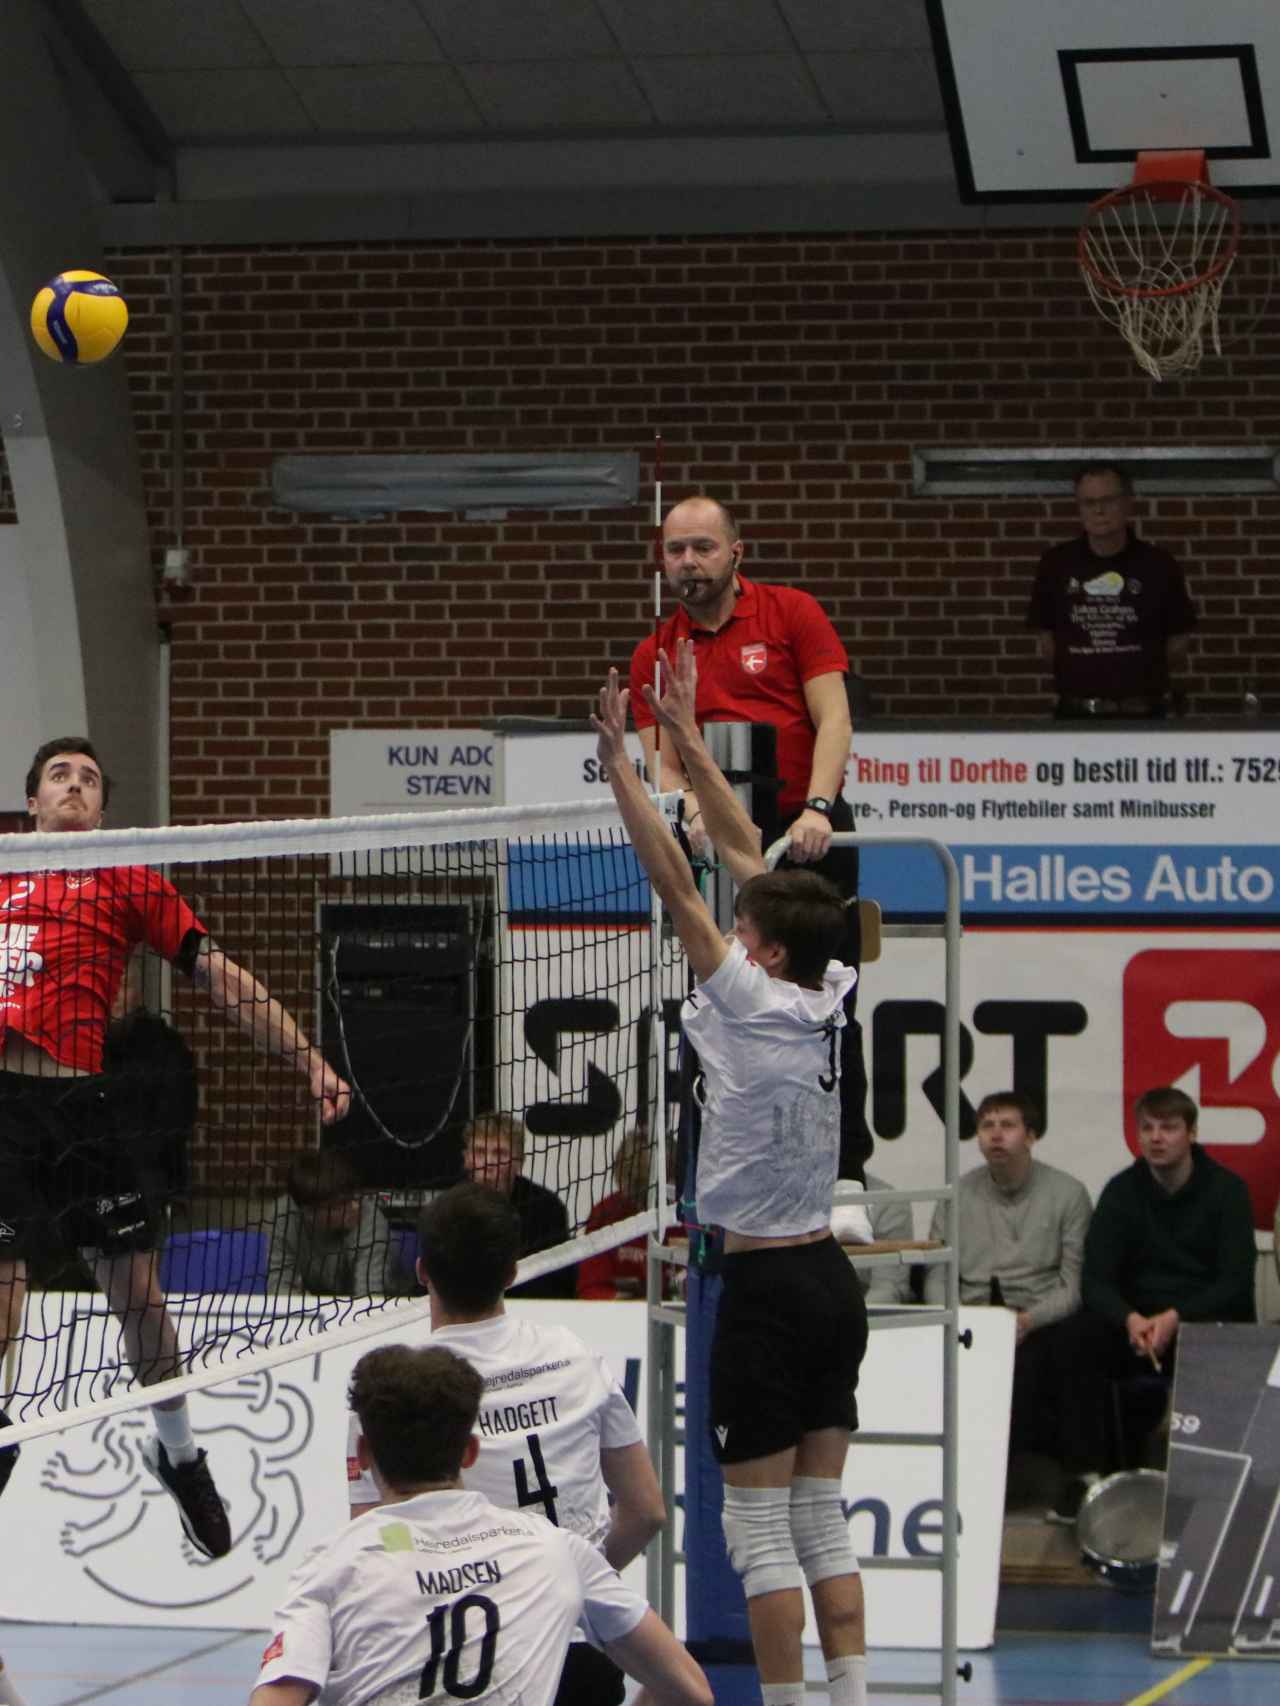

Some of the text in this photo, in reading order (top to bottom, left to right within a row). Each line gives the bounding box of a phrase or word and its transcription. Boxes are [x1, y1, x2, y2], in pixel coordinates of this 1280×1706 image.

[388, 746, 438, 766] KUN
[918, 757, 941, 783] til
[949, 757, 1028, 783] Dorthe
[1036, 762, 1064, 786] og
[1074, 757, 1138, 783] bestil
[1146, 757, 1177, 783] tid
[1185, 757, 1224, 783] tlf.:
[407, 775, 491, 795] STÆVN
[889, 800, 976, 820] Person-og
[982, 799, 1067, 820] Flyttebiler
[1073, 800, 1115, 818] samt
[1120, 799, 1216, 818] Minibusser
[963, 854, 1274, 902] Halles Auto
[480, 1396, 559, 1437] HADGETT
[513, 1433, 560, 1528] 4
[416, 1559, 501, 1594] MADSEN
[420, 1593, 501, 1700] 10
